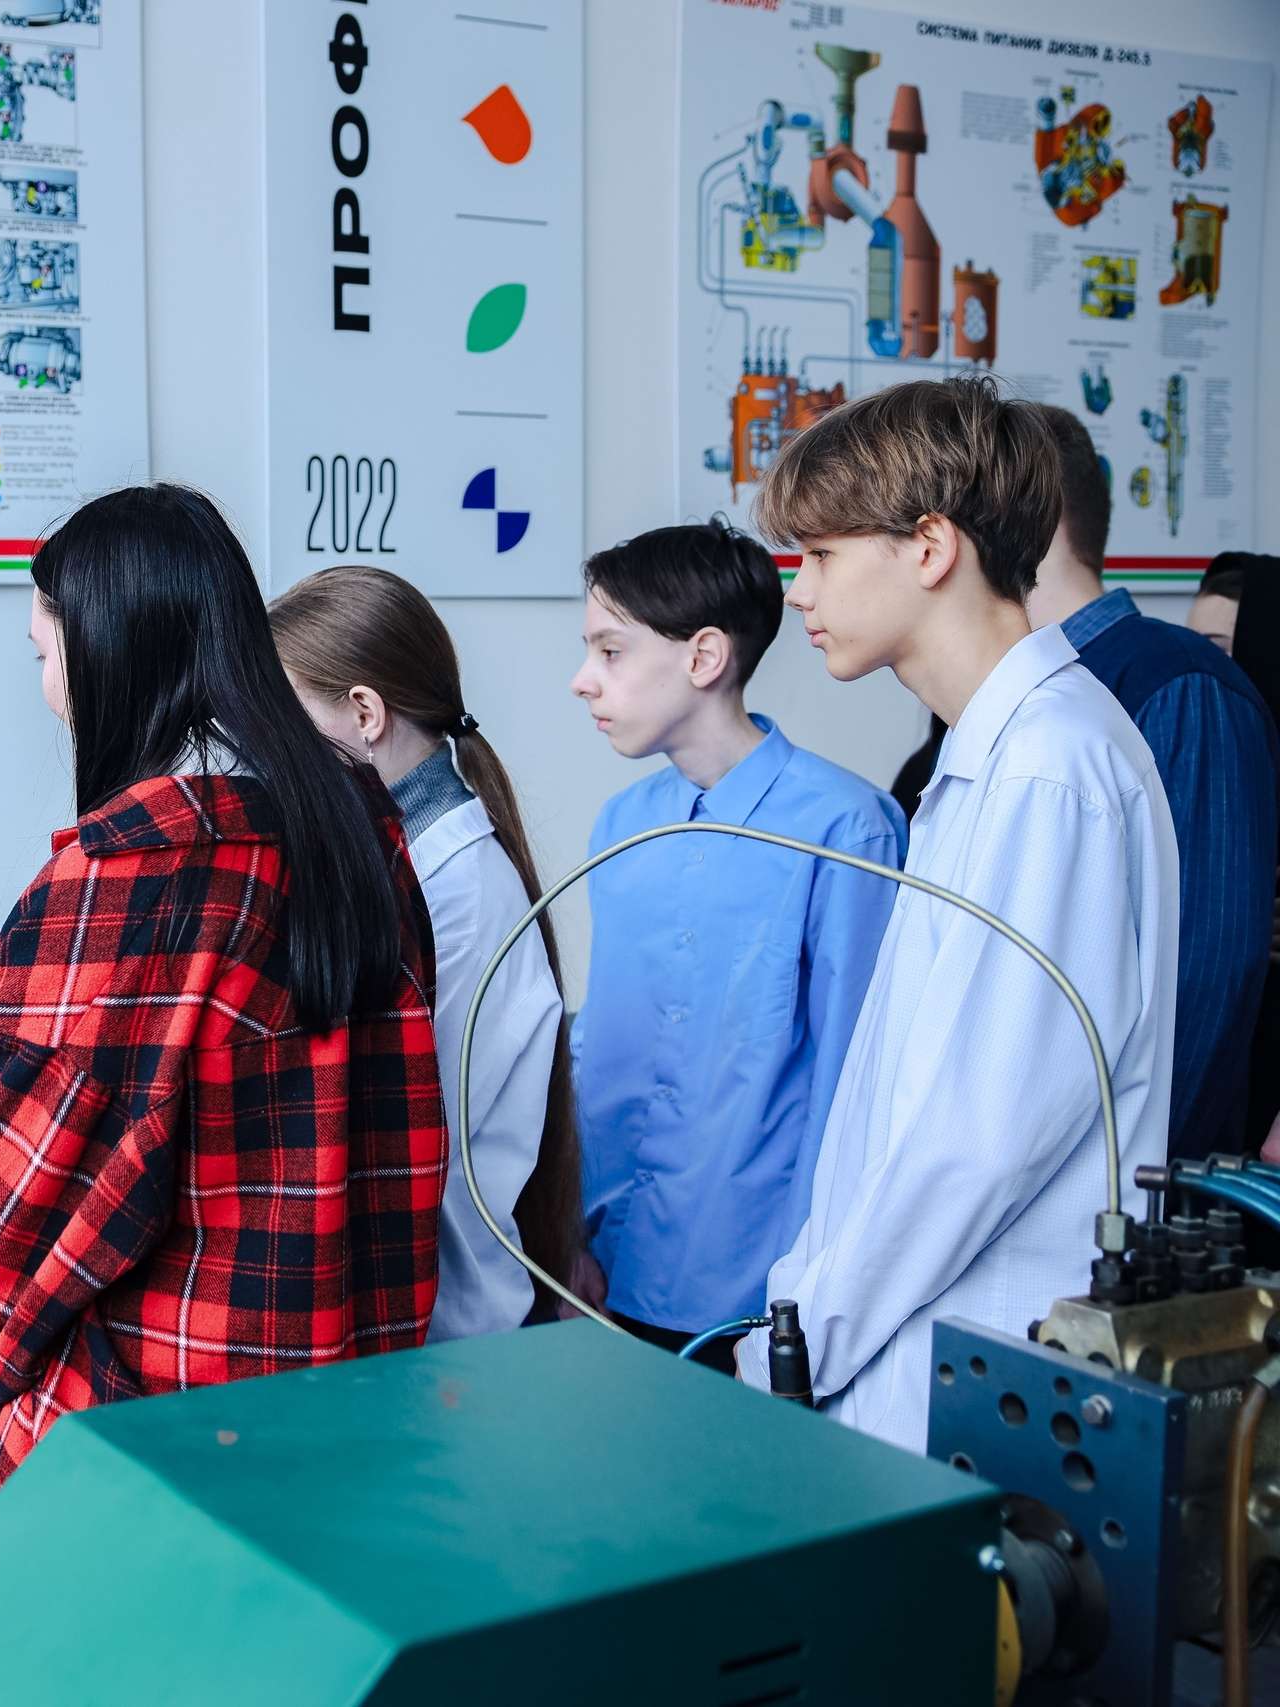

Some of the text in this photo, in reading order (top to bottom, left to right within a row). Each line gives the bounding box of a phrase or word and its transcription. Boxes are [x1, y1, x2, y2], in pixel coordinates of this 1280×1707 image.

[917, 20, 978, 42] СИСТЕМА
[984, 30, 1043, 52] ПИТАНИЯ
[1047, 38, 1099, 59] ДИЗЕЛЯ
[329, 0, 370, 333] ПРОФ
[306, 455, 396, 553] 2022
